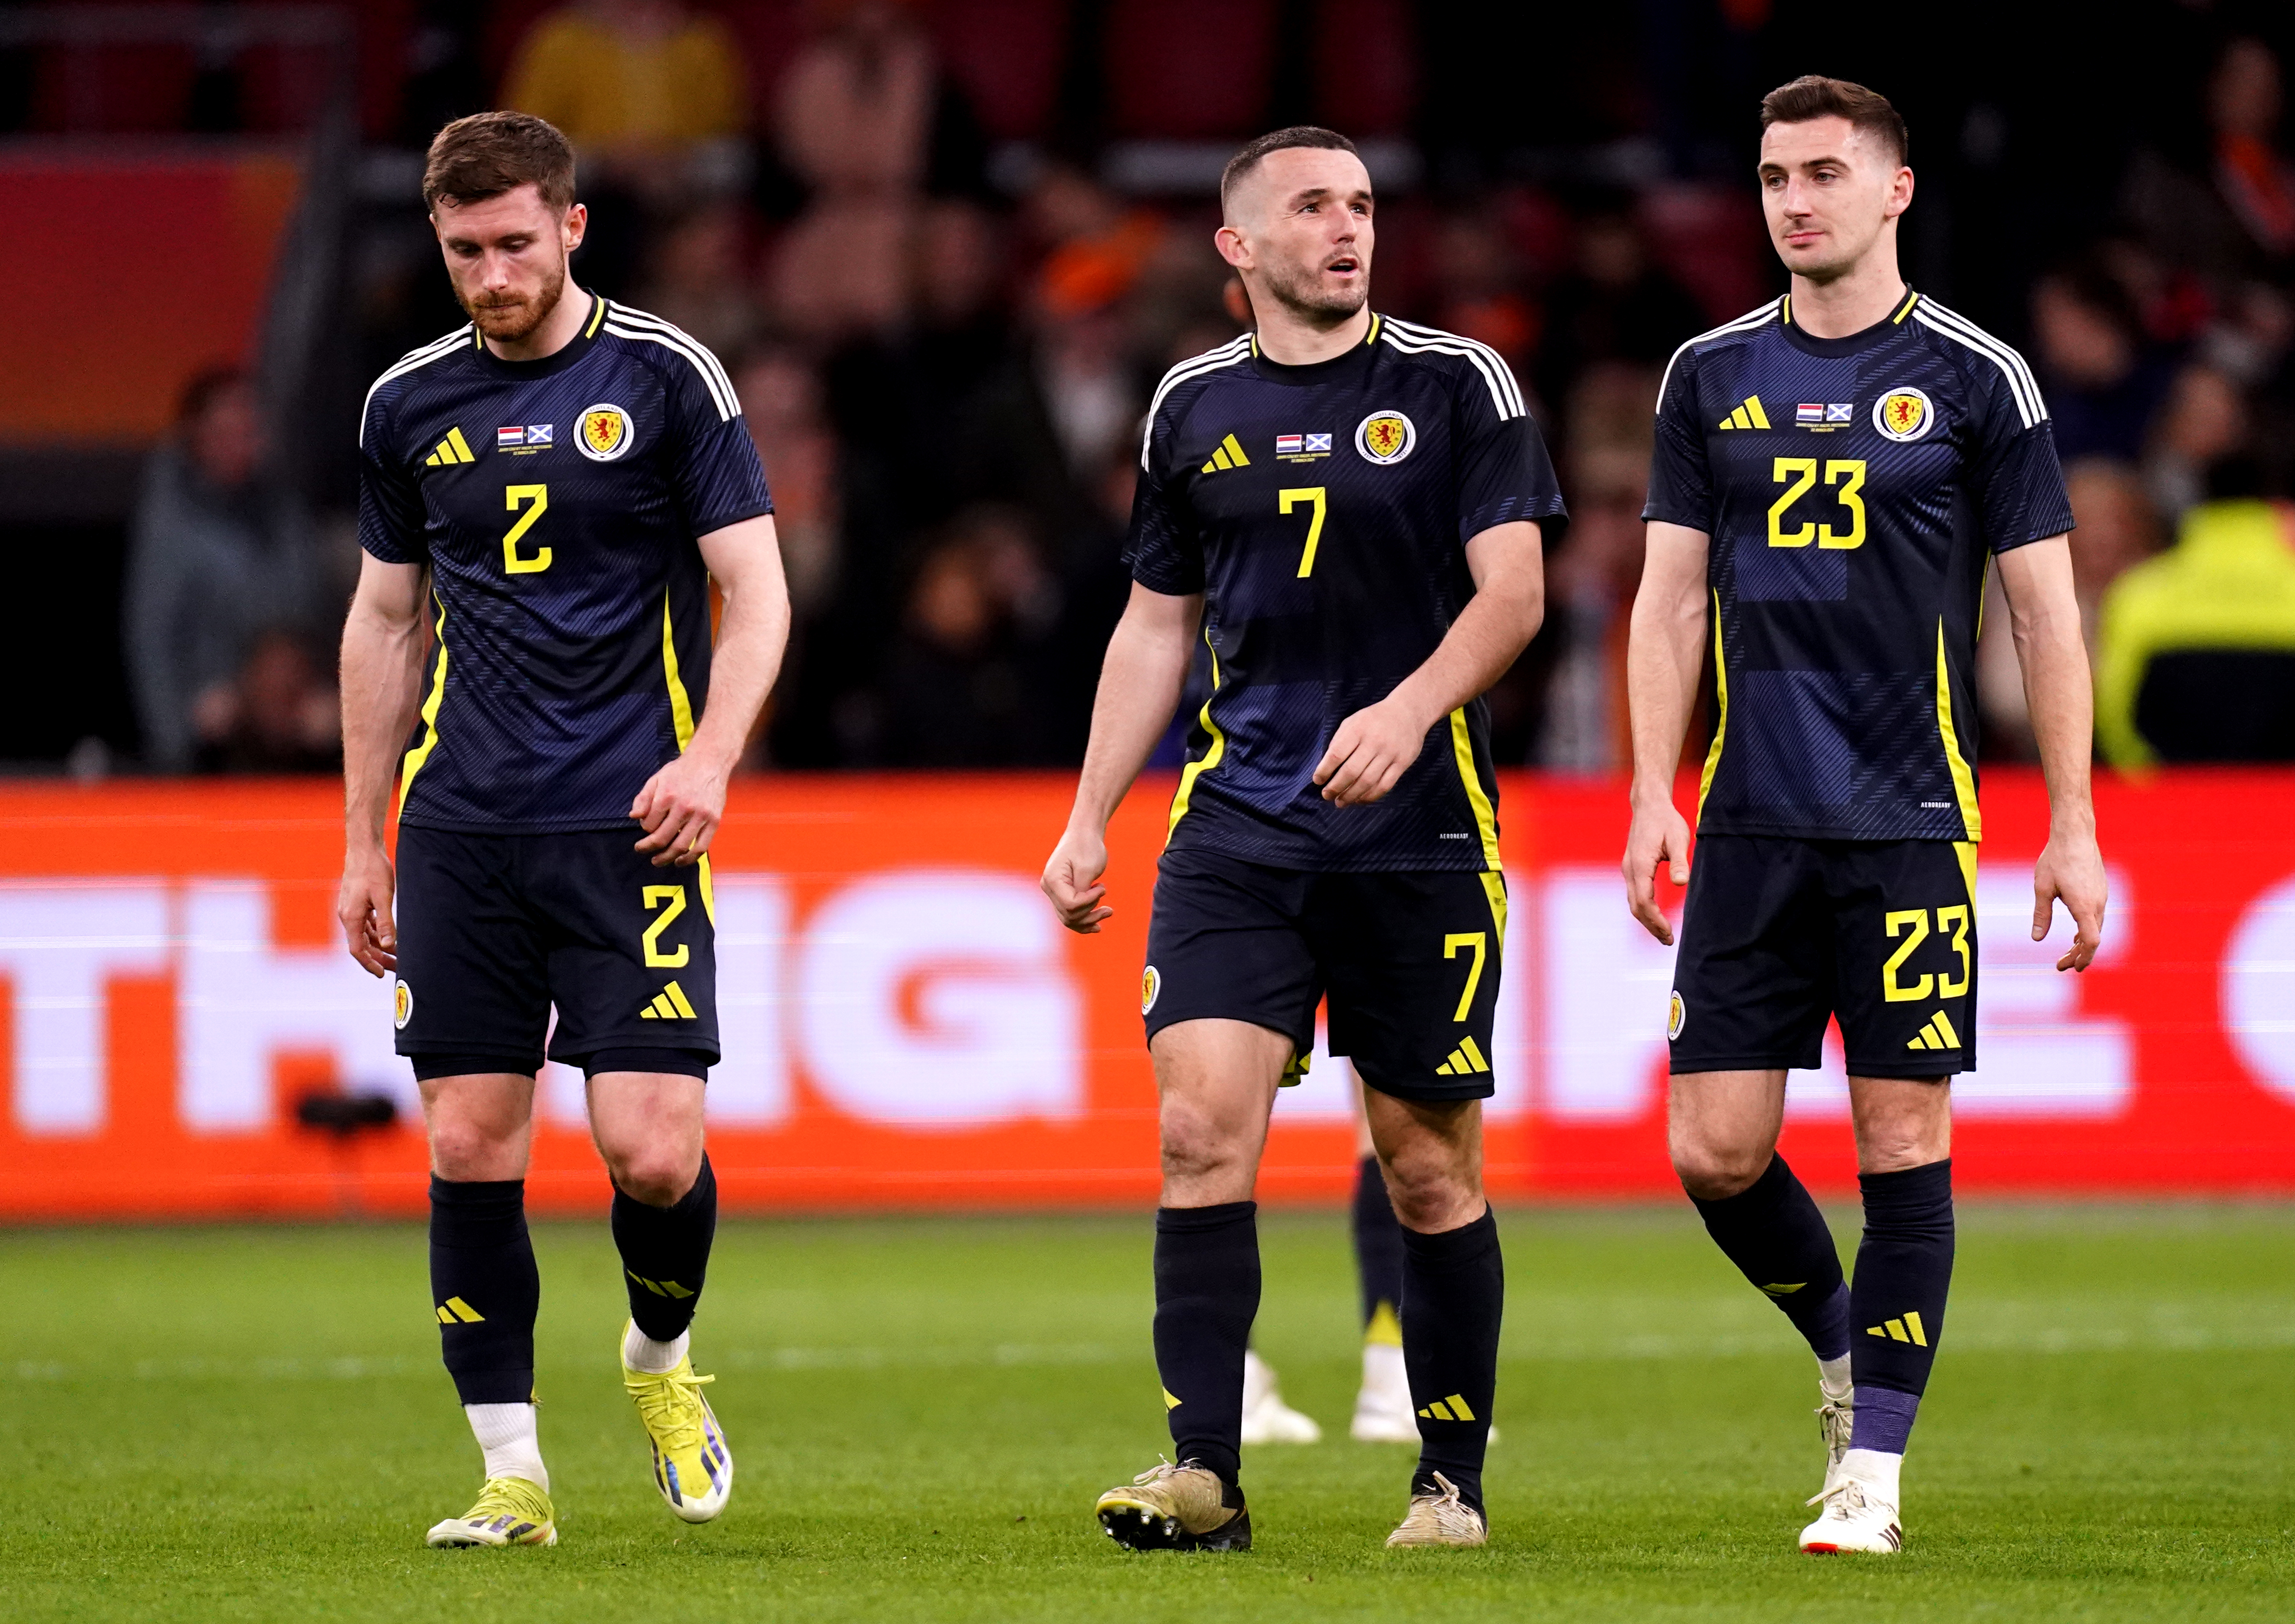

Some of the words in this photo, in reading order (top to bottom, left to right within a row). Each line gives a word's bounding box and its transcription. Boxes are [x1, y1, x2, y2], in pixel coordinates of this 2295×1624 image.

[503, 484, 552, 574] 2
[1278, 487, 1327, 578] 7
[1768, 458, 1866, 549] 23
[642, 885, 690, 968] 2
[1882, 904, 1970, 1003] 23
[1443, 932, 1486, 1022] 7
